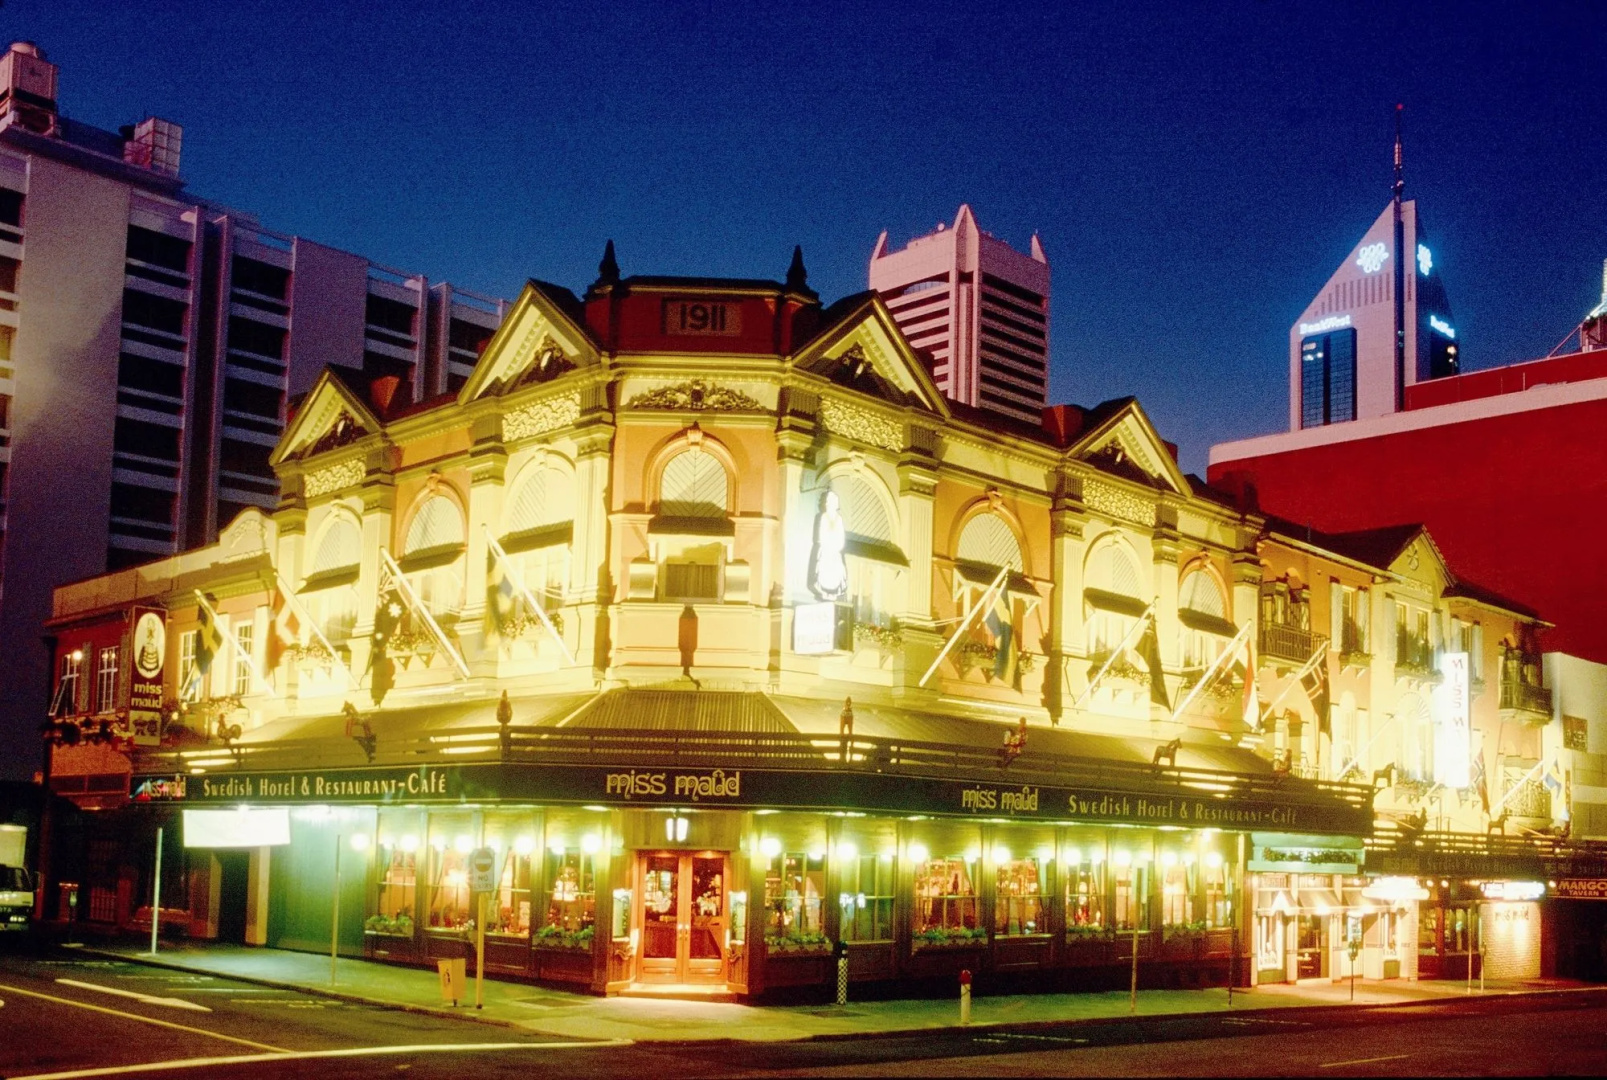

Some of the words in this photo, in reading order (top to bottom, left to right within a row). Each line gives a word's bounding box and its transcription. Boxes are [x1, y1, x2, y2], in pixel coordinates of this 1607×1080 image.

[680, 304, 726, 331] 1911
[134, 682, 163, 695] miss
[131, 696, 162, 708] maud
[203, 778, 253, 797] Swedish
[259, 776, 295, 796] Hotel
[301, 776, 310, 796] &
[606, 769, 667, 799] miss
[962, 784, 997, 813] miss
[1069, 795, 1130, 816] Swedish
[1137, 799, 1173, 818] Hotel
[1180, 801, 1188, 819] &
